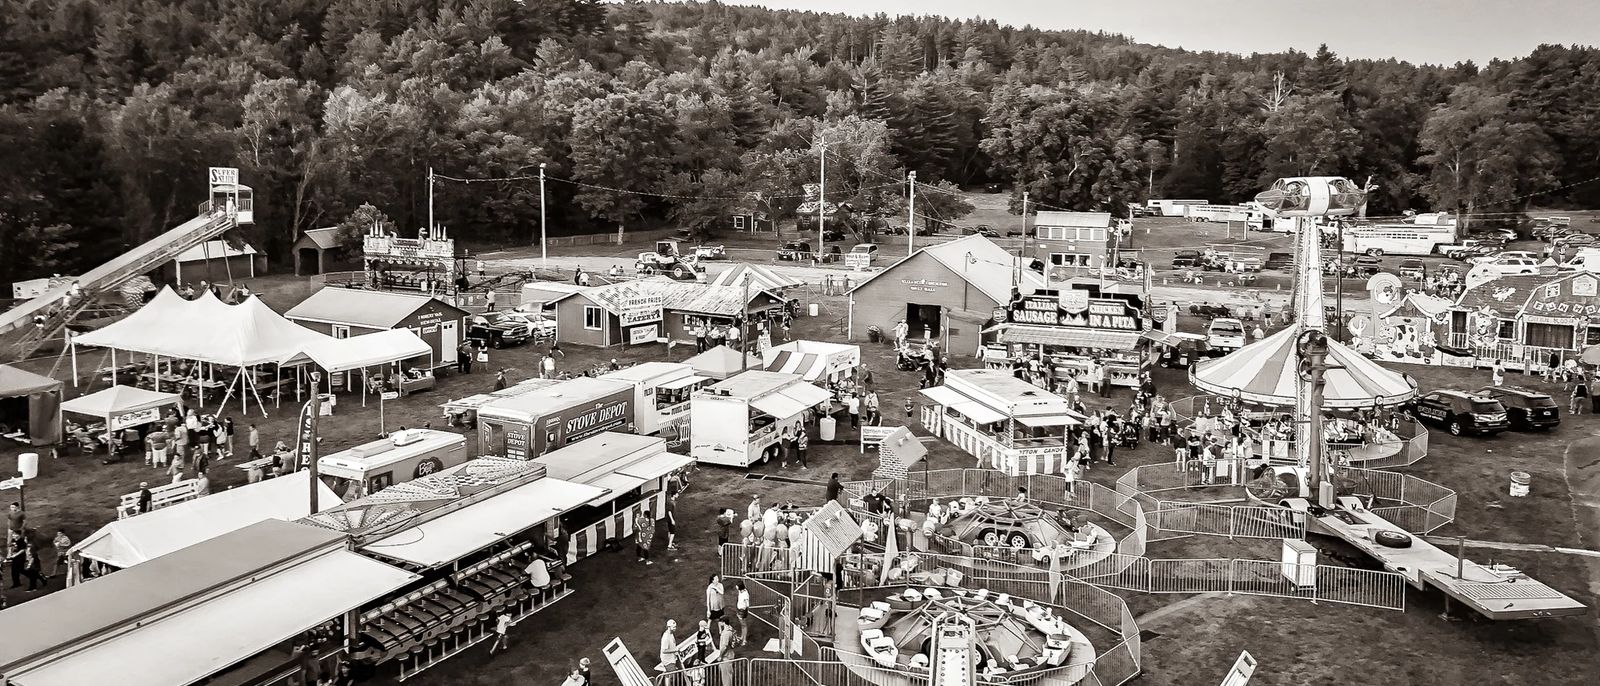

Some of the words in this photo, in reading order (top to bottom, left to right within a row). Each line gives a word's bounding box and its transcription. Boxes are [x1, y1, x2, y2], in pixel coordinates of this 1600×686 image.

[1024, 300, 1058, 311] ITALIAN
[1089, 304, 1125, 315] CHICKEN
[1534, 302, 1568, 312] FUN
[1012, 309, 1058, 324] SAUSAGE
[1089, 314, 1102, 327] IN
[1102, 316, 1111, 328] A
[1112, 316, 1137, 329] PITA
[566, 411, 597, 434] STOVE
[599, 401, 627, 422] DEPOT
[507, 432, 525, 440] STOVE
[507, 438, 525, 446] DEPOT
